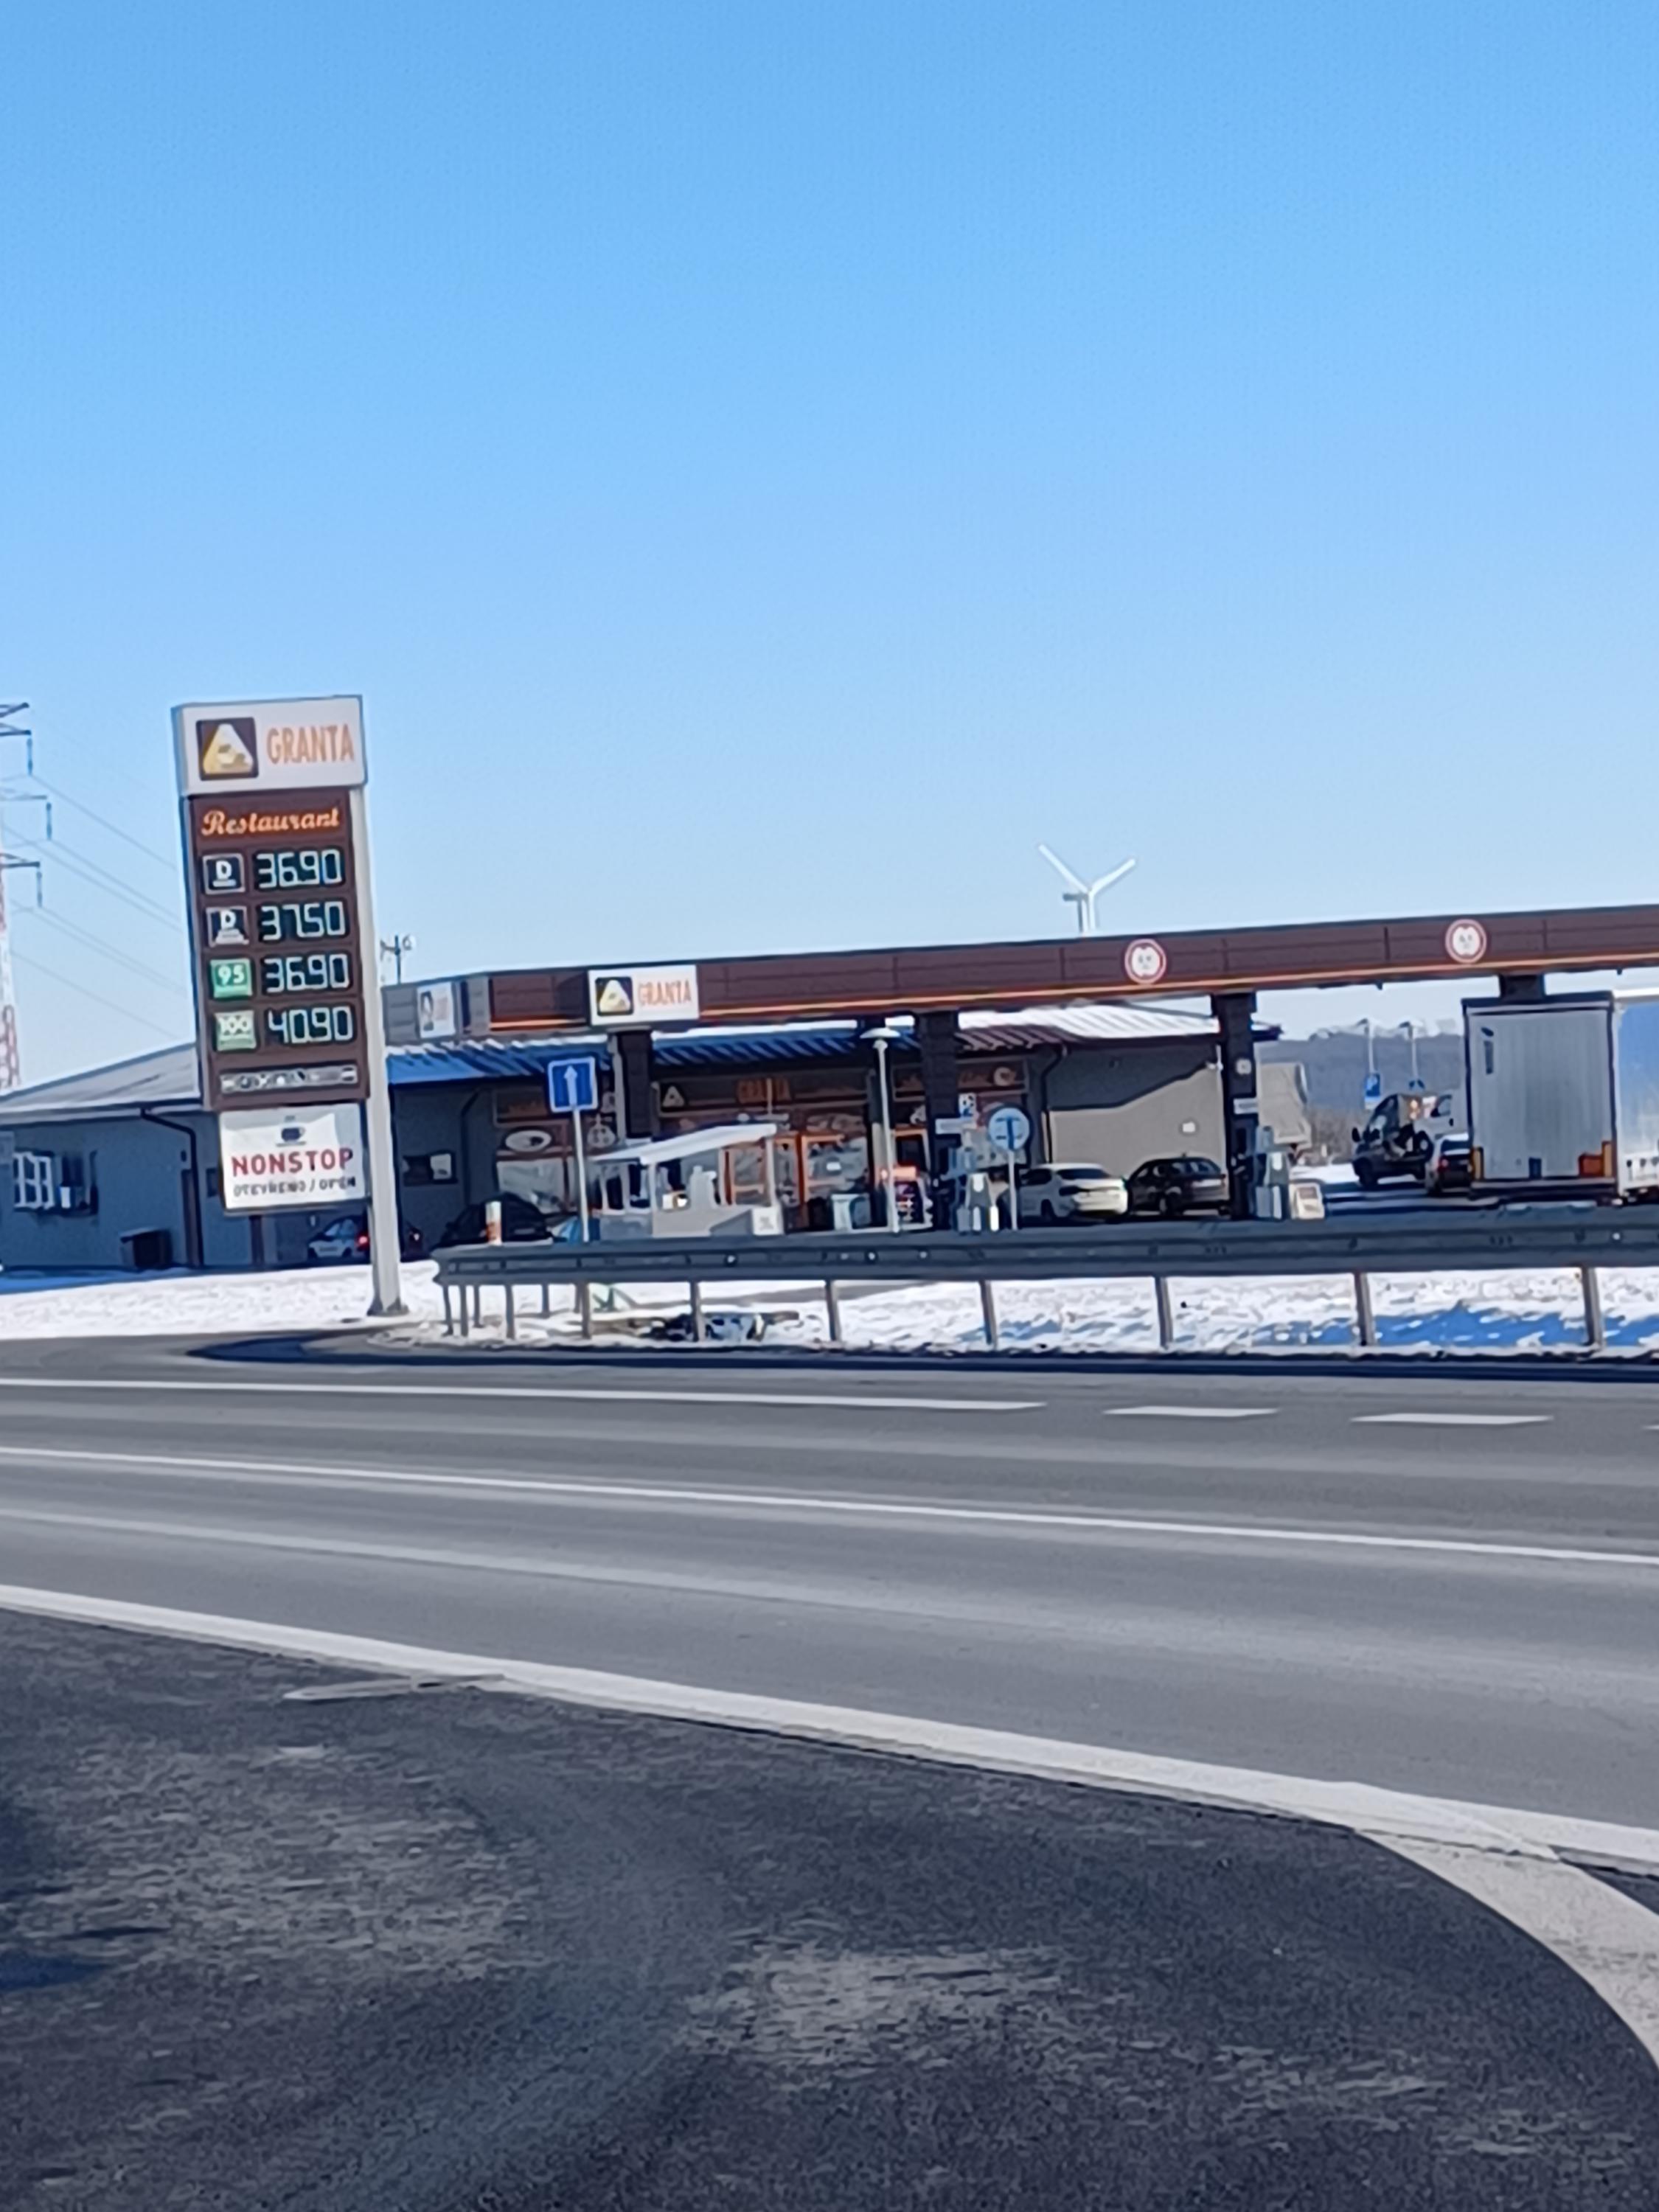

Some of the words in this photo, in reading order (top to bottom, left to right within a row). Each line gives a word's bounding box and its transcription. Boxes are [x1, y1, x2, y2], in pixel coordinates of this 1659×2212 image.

[266, 724, 354, 765] GRANTA
[201, 807, 340, 835] Restaurant
[218, 964, 245, 986] 95
[231, 1148, 354, 1178] NONSTOP
